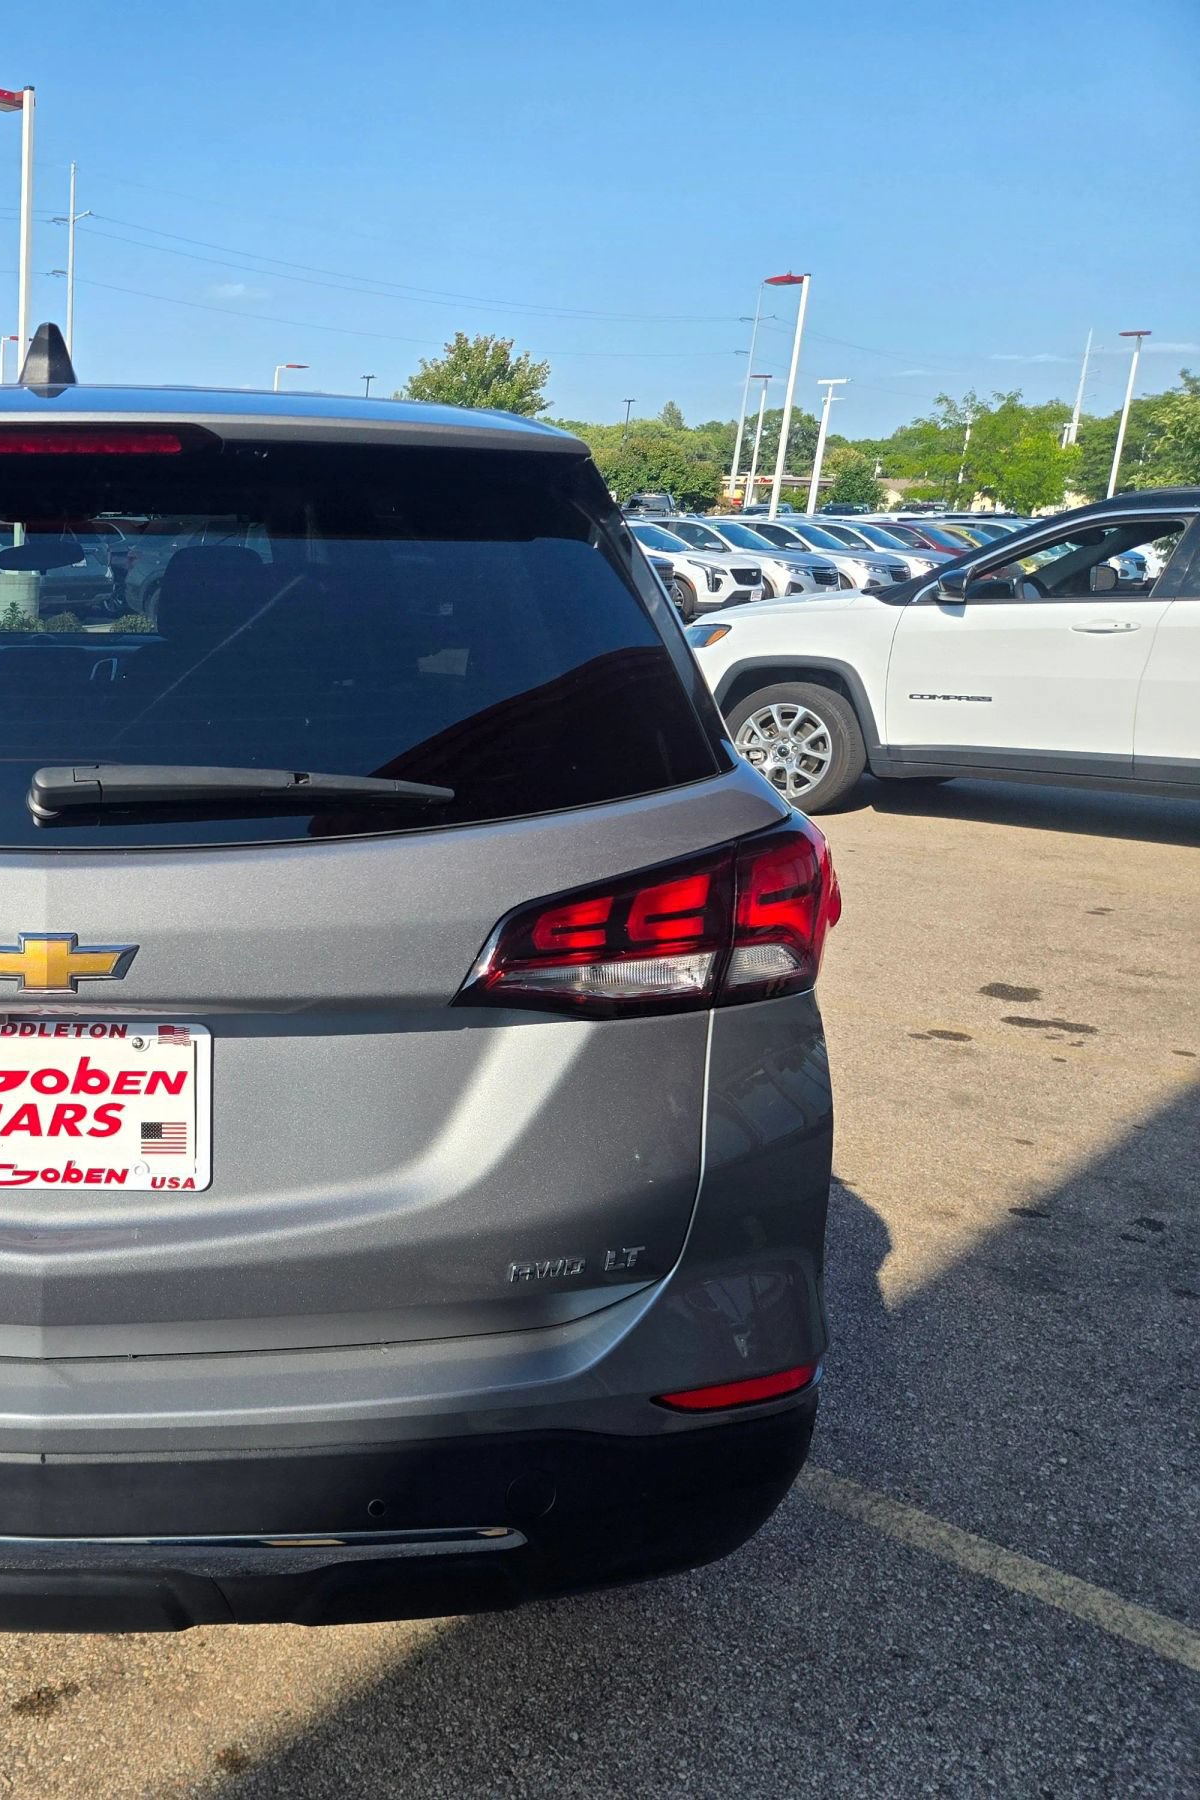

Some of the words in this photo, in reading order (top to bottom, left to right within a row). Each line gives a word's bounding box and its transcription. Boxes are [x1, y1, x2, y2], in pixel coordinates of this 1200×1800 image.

[909, 694, 992, 702] COMPASS
[150, 1176, 196, 1189] USA
[508, 1257, 586, 1283] AWD
[604, 1246, 647, 1271] LT
